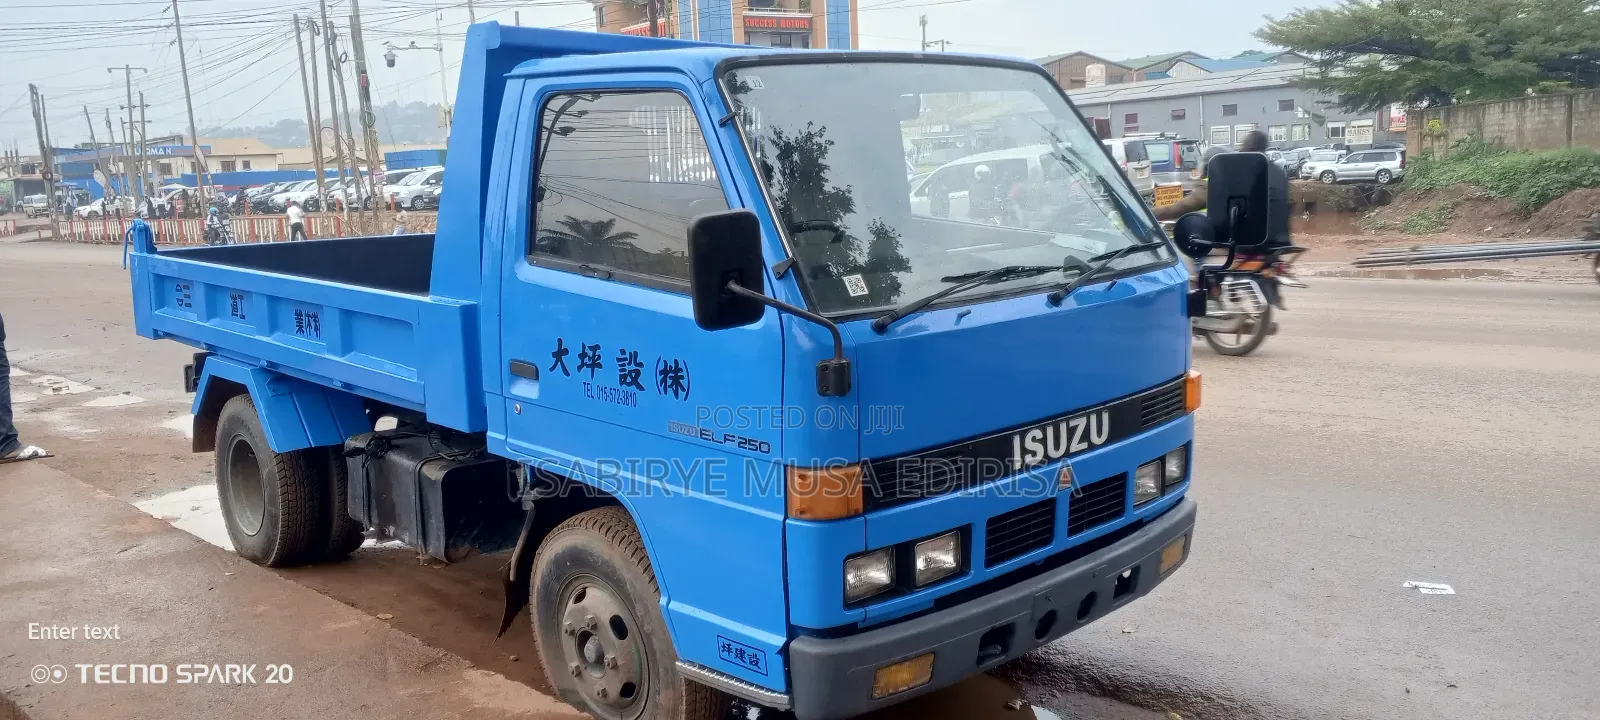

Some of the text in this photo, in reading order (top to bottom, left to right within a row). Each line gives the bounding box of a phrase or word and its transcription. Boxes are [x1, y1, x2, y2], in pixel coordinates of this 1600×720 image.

[745, 18, 809, 29] SUCCESS MOTORS
[582, 381, 595, 399] TEL
[669, 423, 696, 437] ISUZU
[1012, 409, 1109, 471] ISUZU
[720, 641, 762, 670] 坪建設
